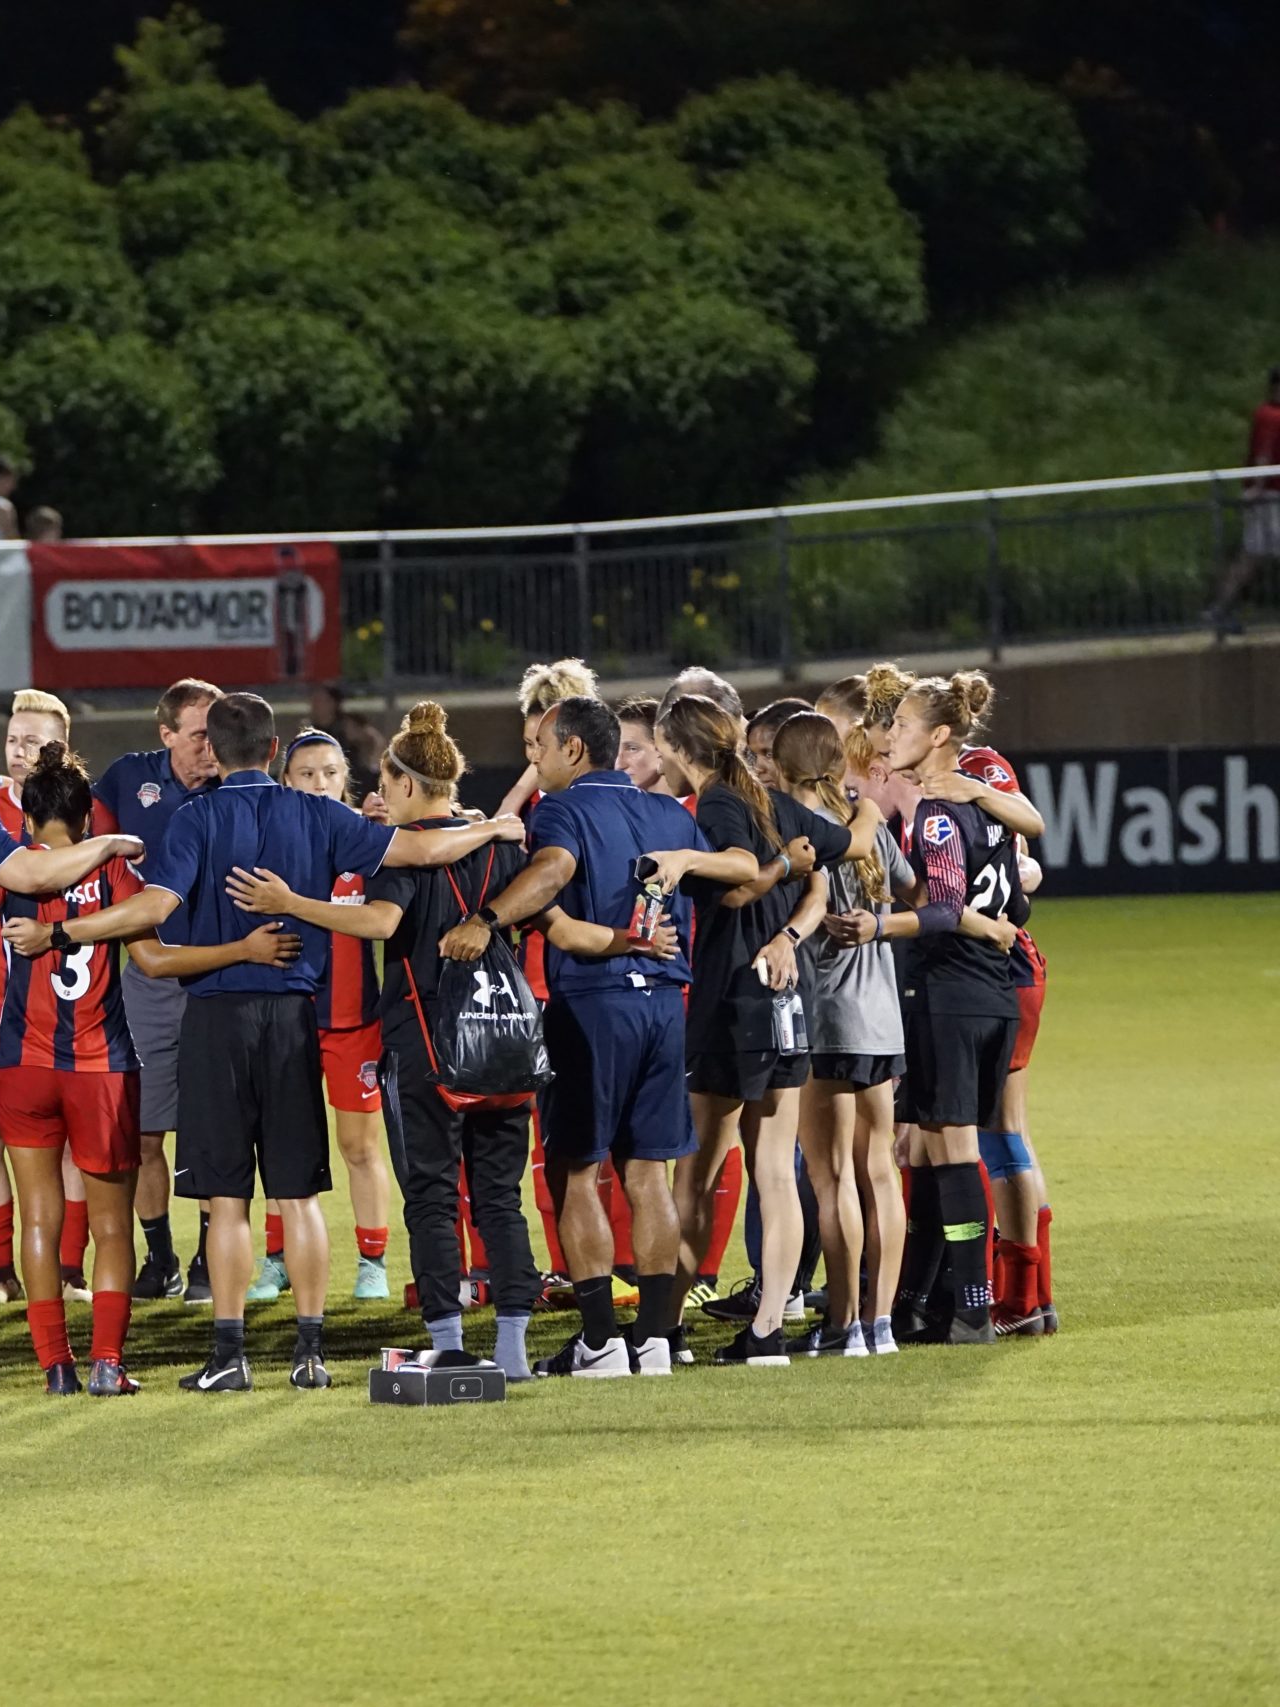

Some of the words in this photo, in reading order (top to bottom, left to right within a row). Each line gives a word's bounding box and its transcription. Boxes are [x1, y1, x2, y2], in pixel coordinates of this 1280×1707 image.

[63, 589, 267, 632] BODYARMOR
[1026, 755, 1280, 868] Wash
[50, 941, 94, 1000] 3
[459, 1012, 498, 1020] UNDER
